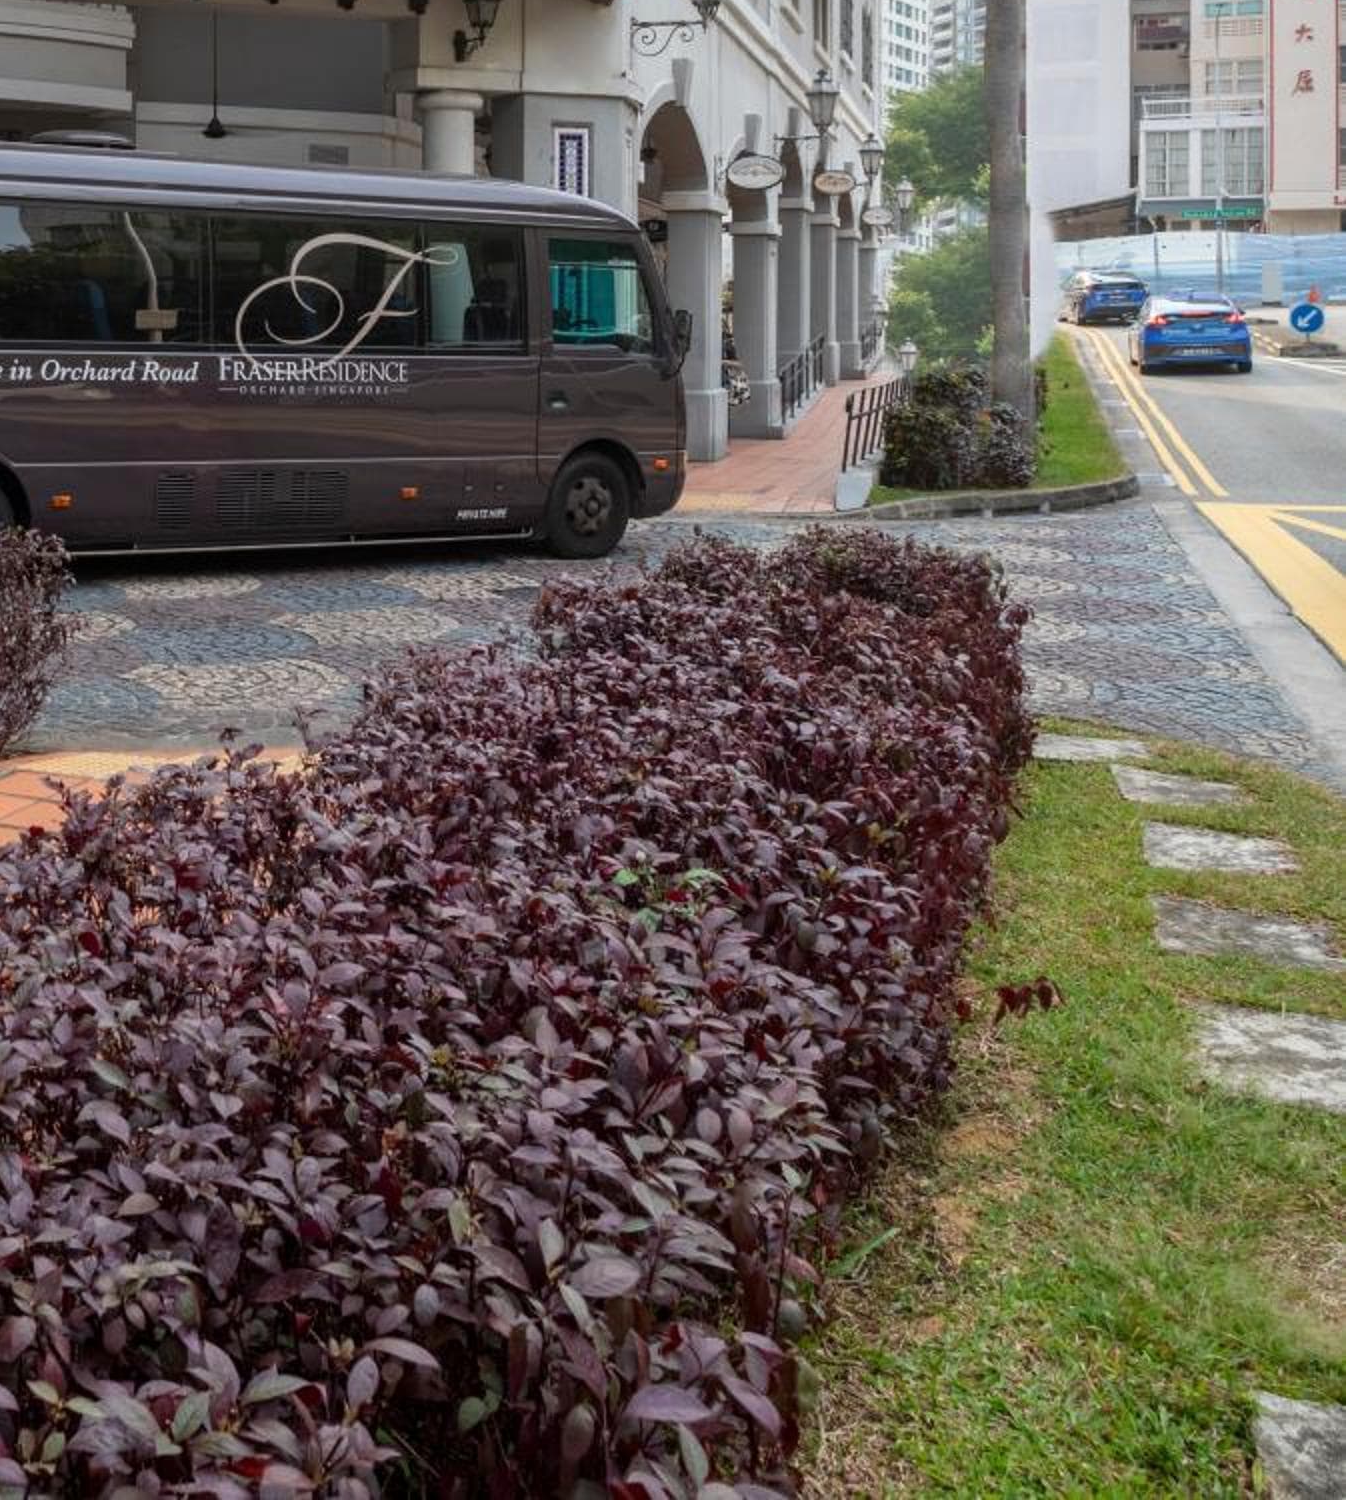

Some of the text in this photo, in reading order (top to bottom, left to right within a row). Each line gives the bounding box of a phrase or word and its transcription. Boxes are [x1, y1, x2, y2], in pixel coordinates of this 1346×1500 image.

[9, 359, 33, 381] in
[41, 359, 135, 382] Orchard
[141, 361, 200, 382] Road
